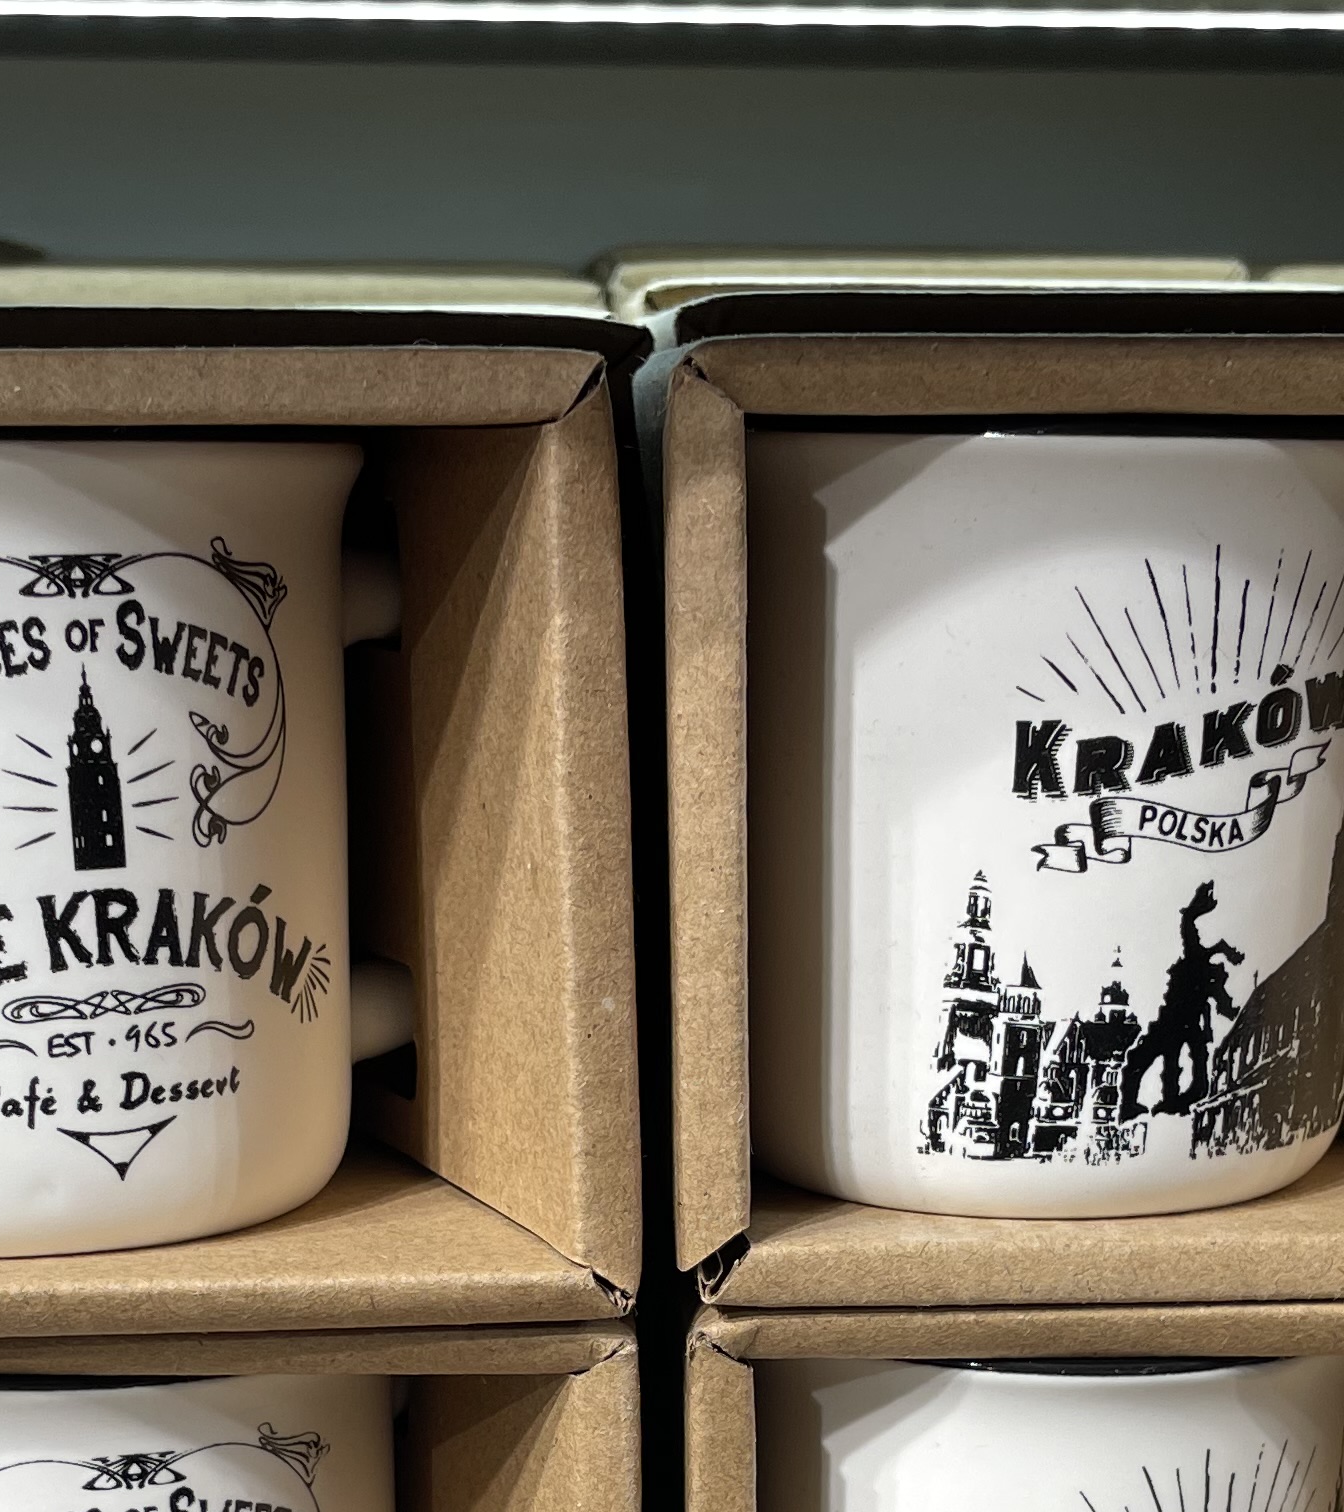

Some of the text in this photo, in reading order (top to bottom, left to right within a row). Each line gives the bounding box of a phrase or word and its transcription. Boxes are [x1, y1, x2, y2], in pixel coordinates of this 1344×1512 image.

[65, 619, 105, 653] OF
[115, 600, 265, 706] SWEETS
[1139, 804, 1244, 846] POLSKA
[36, 884, 313, 1004] KRAKÓW
[126, 1022, 178, 1052] 965
[77, 1078, 102, 1113] &
[119, 1067, 241, 1111] Dessert
